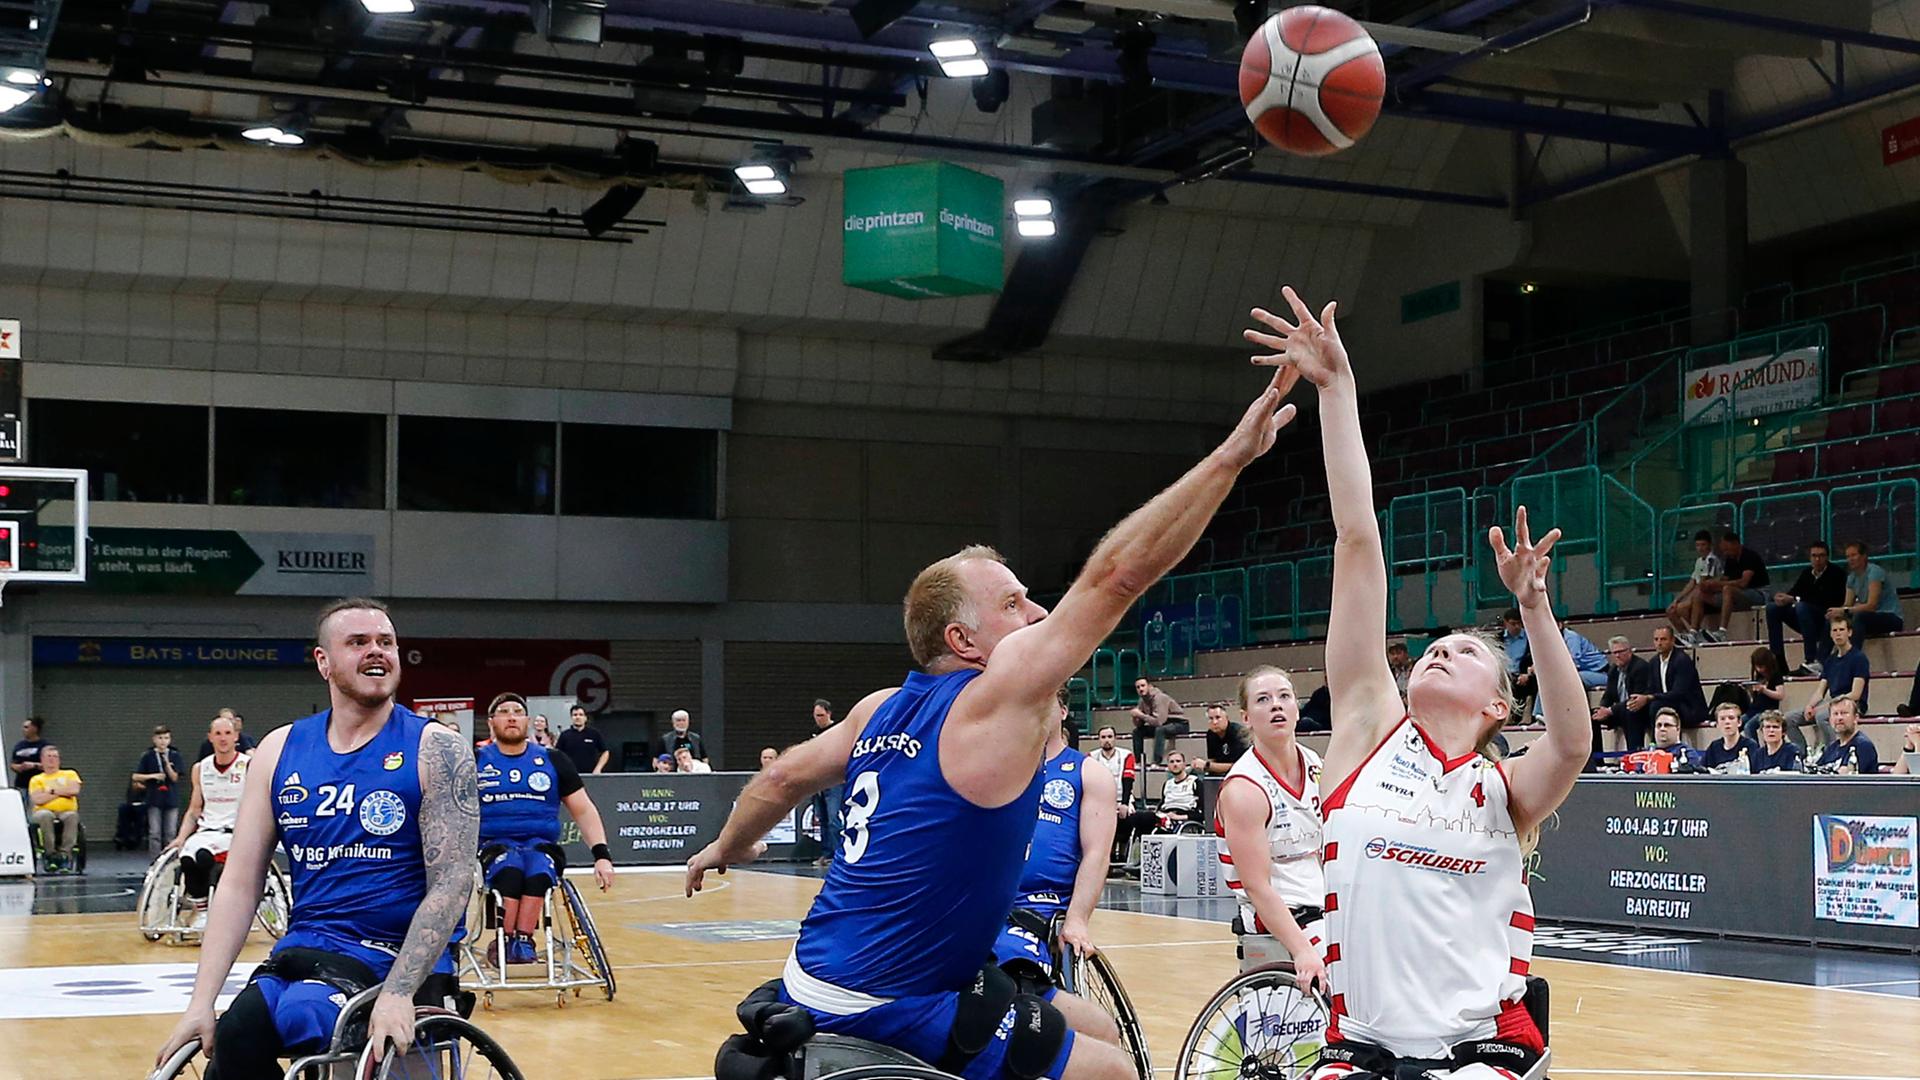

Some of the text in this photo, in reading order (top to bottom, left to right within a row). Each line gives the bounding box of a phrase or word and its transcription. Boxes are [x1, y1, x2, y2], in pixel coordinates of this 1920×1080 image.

[845, 215, 864, 230] die
[865, 212, 924, 231] printzen
[939, 208, 953, 225] die
[954, 213, 995, 237] printzen
[102, 545, 144, 557] Events
[147, 545, 159, 557] in
[162, 545, 182, 558] der
[186, 547, 231, 560] Region:
[277, 550, 366, 570] KURIER
[98, 562, 133, 574] steht,
[137, 563, 162, 573] was
[509, 769, 522, 783] 9
[641, 789, 675, 799] WANN:
[1379, 781, 1416, 798] MEYRA
[1470, 782, 1486, 808] 4
[316, 784, 355, 816] 24
[664, 801, 675, 811] 17
[678, 801, 700, 811] UHR
[1635, 791, 1676, 808] WANN:
[648, 814, 668, 823] WO:
[1605, 817, 1708, 837] 30.04.AB 17 UHR
[619, 826, 697, 837] HERZOGKELLER
[632, 839, 684, 850] BAYREUTH
[306, 847, 325, 862] BG
[1382, 847, 1487, 874] SCHUBERT
[1644, 845, 1668, 863] WO:
[1609, 869, 1706, 893] HERZOGKELLER
[1626, 898, 1691, 919] BAYREUTH
[1272, 1019, 1322, 1037] BECHERT
